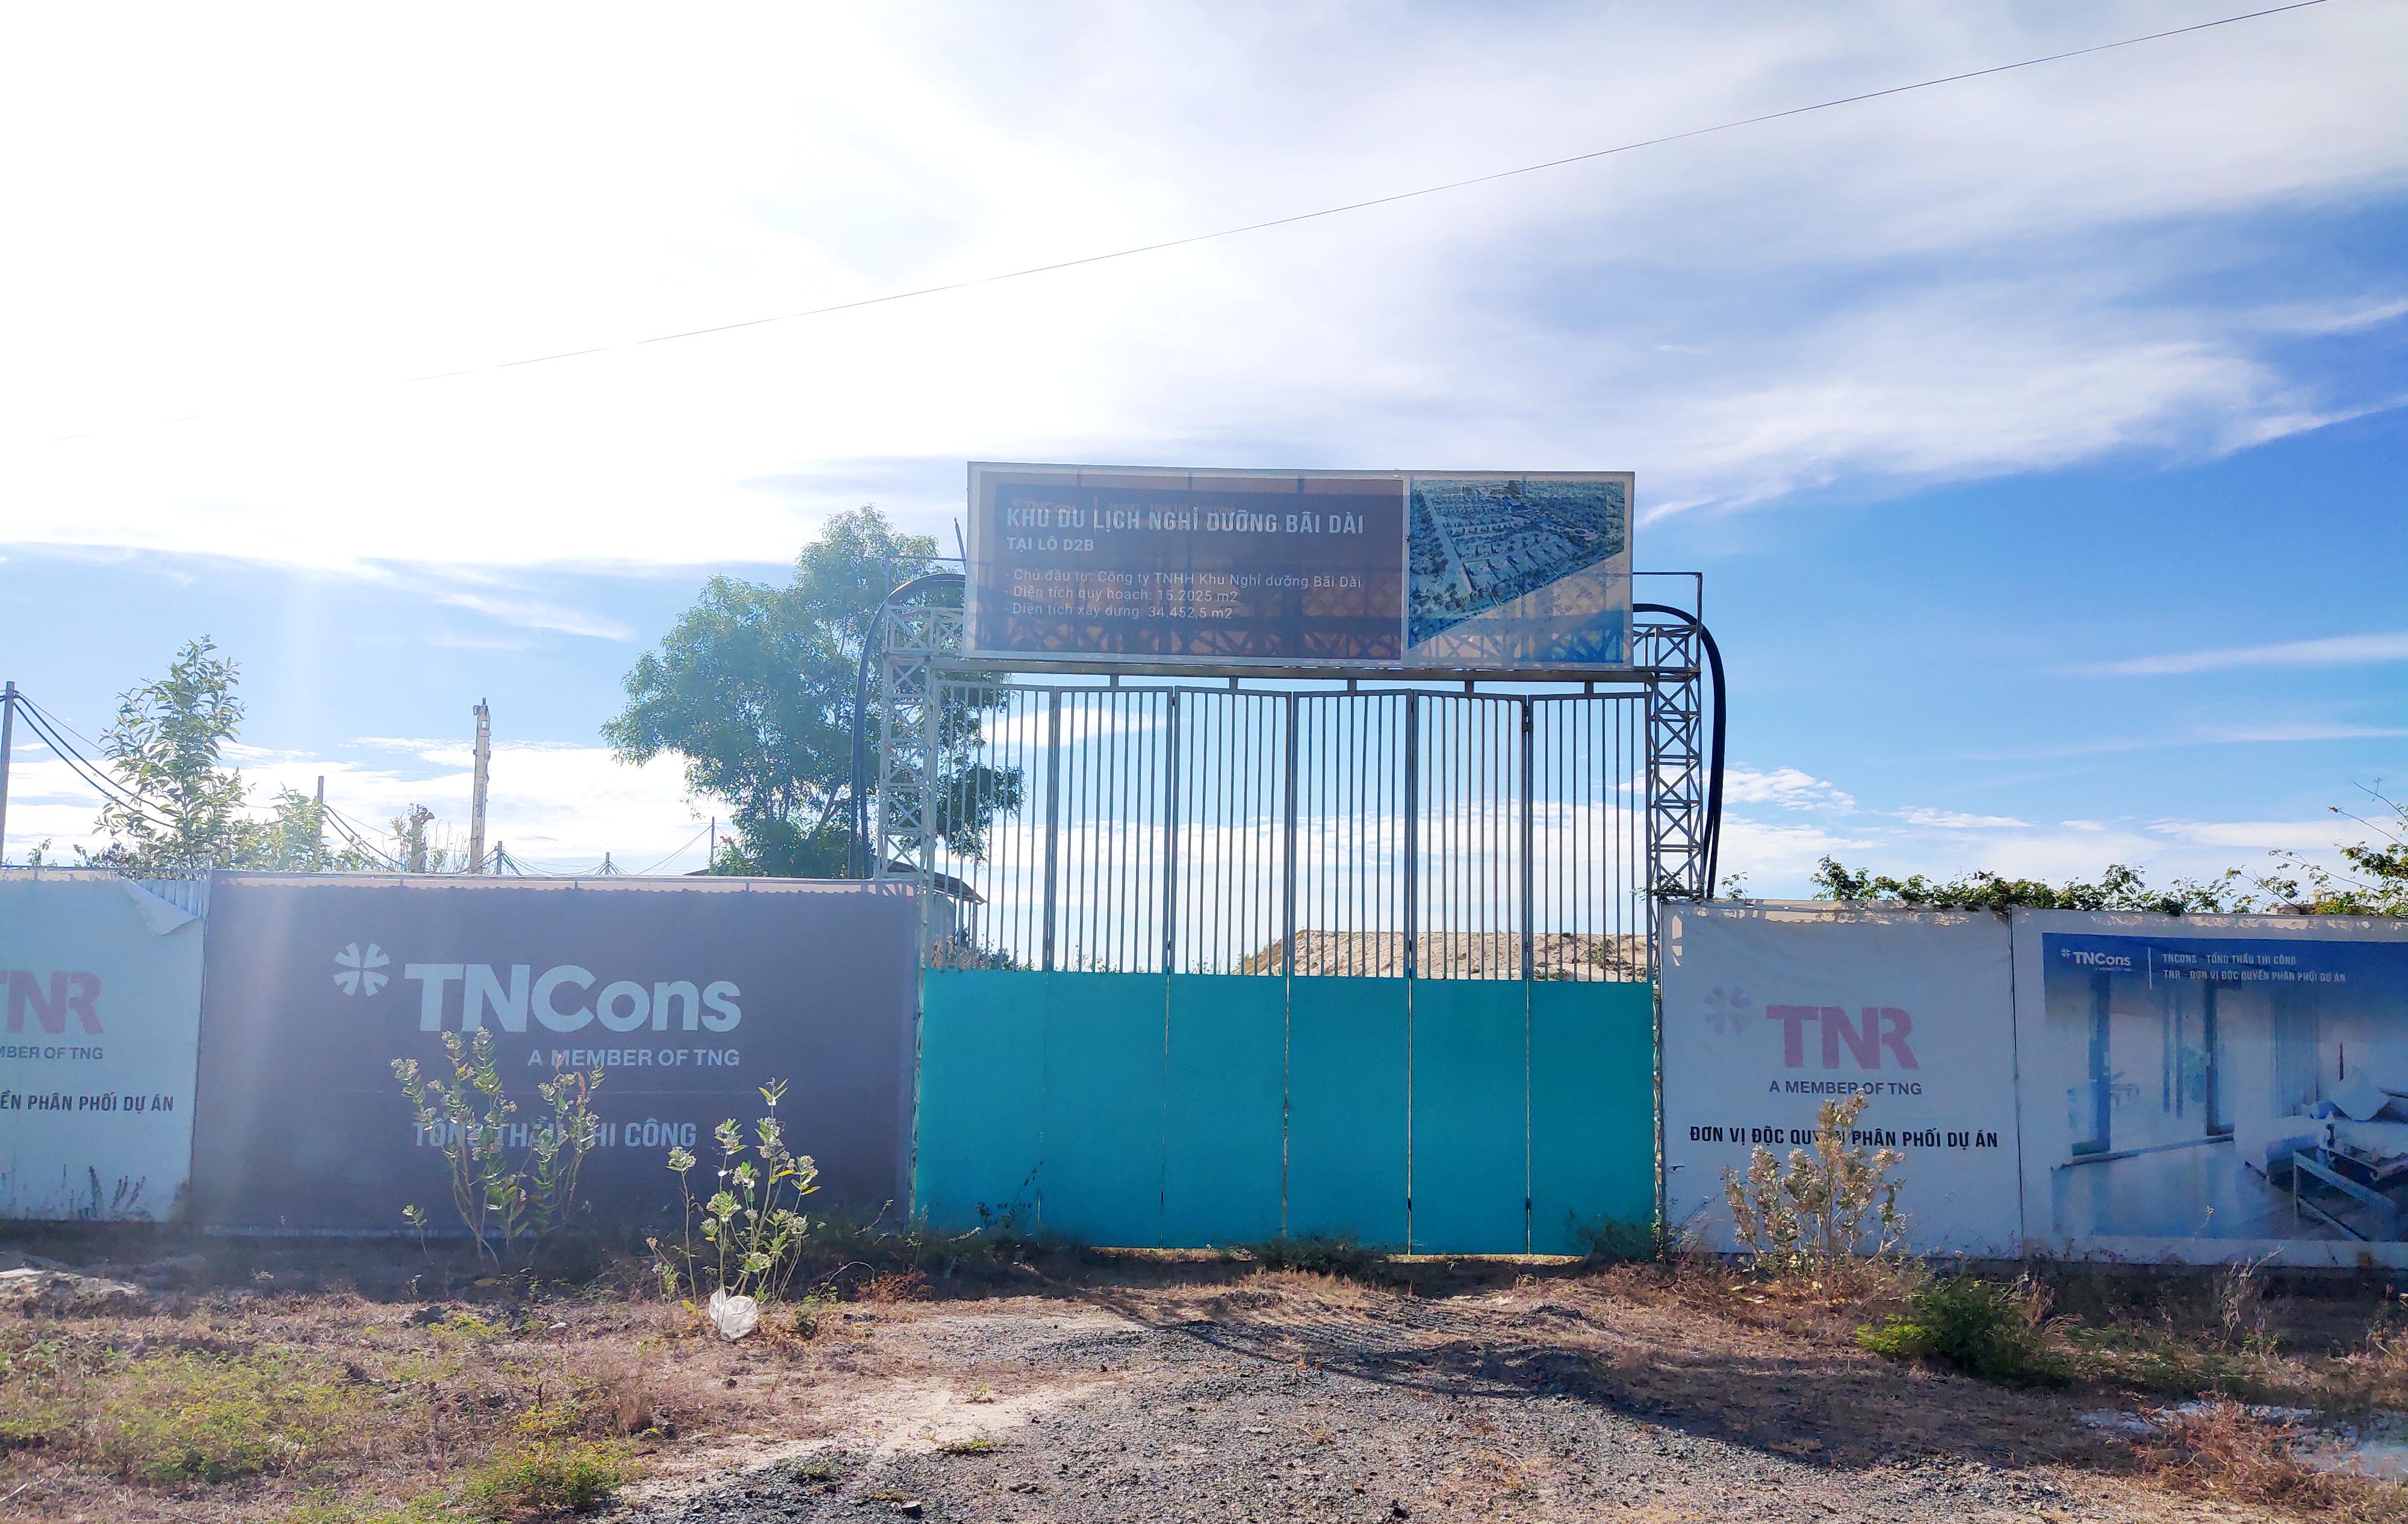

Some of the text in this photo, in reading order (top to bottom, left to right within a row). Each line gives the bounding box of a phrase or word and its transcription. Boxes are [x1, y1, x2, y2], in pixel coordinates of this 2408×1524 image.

[1007, 507, 1049, 528] KHU
[1058, 509, 1084, 528] DU
[1093, 509, 1140, 533] LỊCH
[1149, 506, 1199, 531] NGHỈ
[1206, 509, 1277, 533] DƯỠNG
[1285, 511, 1320, 533] BÃI
[1329, 511, 1364, 533] DÀI
[1006, 536, 1094, 553] TẠI LÔ D2B
[1014, 568, 1040, 581] Chủ
[1045, 568, 1070, 581] đầu
[1097, 570, 1132, 585] Công
[1137, 572, 1149, 586] ty
[1154, 572, 1194, 584] TNHH
[1200, 572, 1225, 585] Khu
[1265, 574, 1308, 589] dưỡng
[1314, 575, 1334, 588] Bãi
[1340, 576, 1361, 589] Dài
[1014, 586, 1043, 600] Diện
[1048, 586, 1073, 598] tích
[1078, 589, 1102, 602] quy
[1106, 587, 1152, 602] hoạch:
[1157, 589, 1212, 602] 15.2025
[1217, 591, 1238, 602] m2
[1013, 602, 1043, 616] Diện
[1047, 603, 1073, 615] tích
[1078, 606, 1101, 619] xây
[1148, 606, 1207, 620] 34.452,5
[1212, 607, 1232, 619] m2
[2072, 952, 2132, 966] TNCons
[2162, 953, 2197, 964] TNCONS
[2257, 955, 2271, 965] THI
[2164, 970, 2180, 980] TNR
[0, 970, 104, 1034] NR
[404, 964, 742, 1032] TNCons
[1766, 1004, 1920, 1070] TNR
[44, 1046, 66, 1059] OF
[69, 1047, 104, 1060] TNG
[527, 1049, 740, 1067] A MEMBER OF TNG
[1769, 1080, 1922, 1095] A MEMBER OF TNG
[28, 1092, 72, 1111] PHÂN
[79, 1091, 117, 1112] PHỐI
[123, 1095, 146, 1115] DỰ
[150, 1093, 174, 1112] ÁN
[624, 1118, 697, 1147] CÔNG
[1689, 1126, 1723, 1142] ĐƠN
[1729, 1127, 1745, 1145] VỊ
[1752, 1126, 1784, 1146] ĐỘC
[1852, 1128, 1896, 1147] PHÂN
[1902, 1127, 1941, 1148] PHỐI
[1947, 1131, 1970, 1150] DỰ
[1975, 1129, 1998, 1148] ÁN
